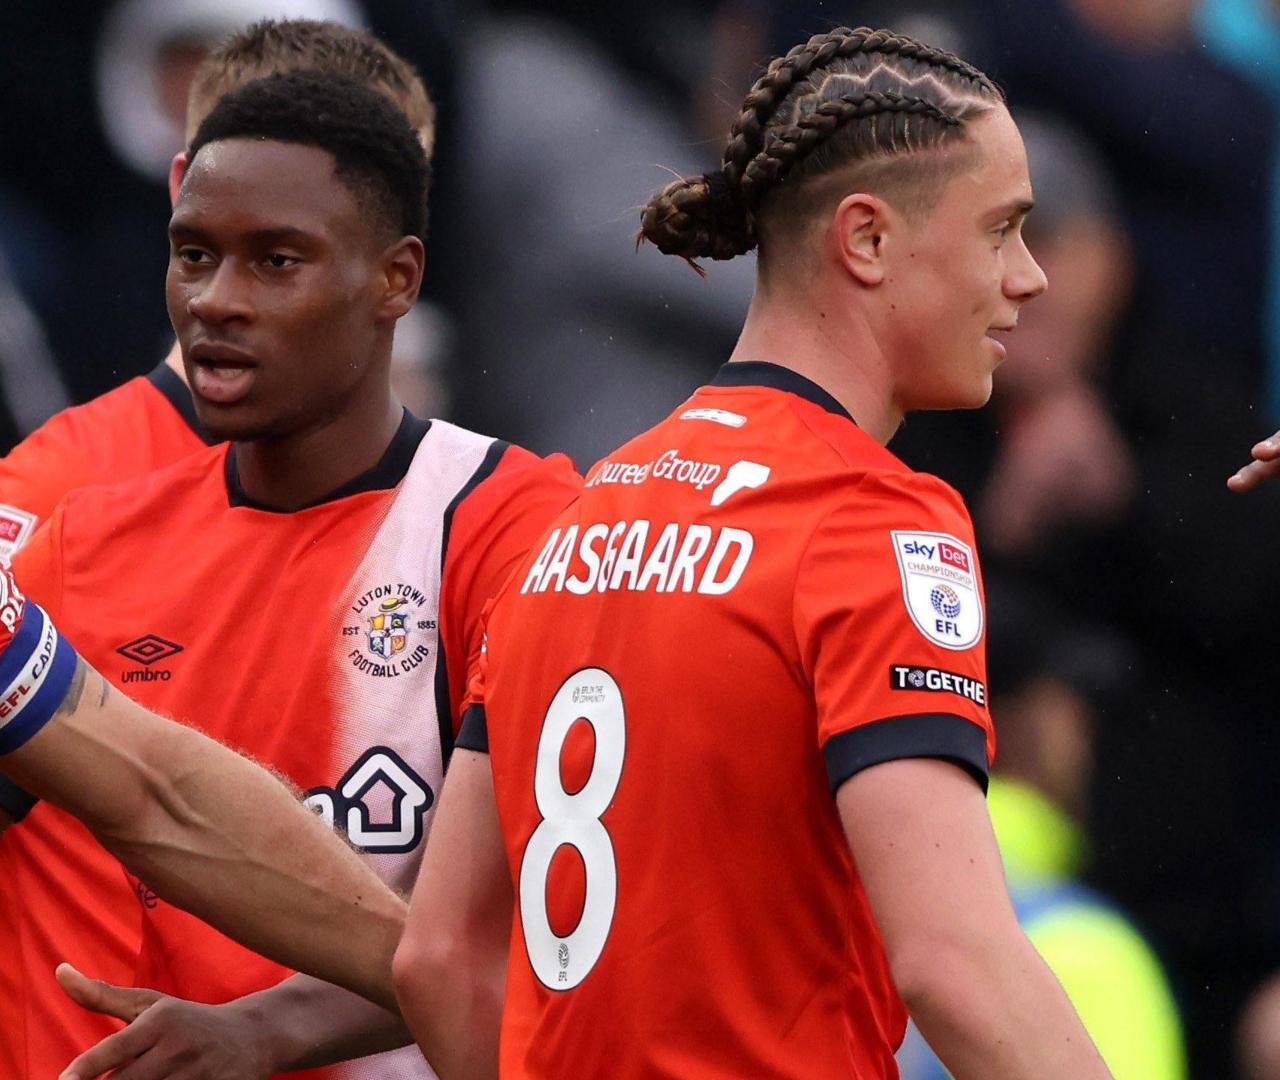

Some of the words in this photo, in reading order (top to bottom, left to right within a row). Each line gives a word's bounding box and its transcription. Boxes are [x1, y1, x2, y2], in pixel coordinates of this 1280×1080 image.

[652, 449, 721, 490] Group
[520, 519, 754, 595] AASGAARD
[903, 541, 935, 560] sky
[942, 545, 968, 568] bet
[352, 584, 392, 614] LUTON
[397, 583, 427, 608] TOWN
[342, 626, 360, 636] EST
[417, 620, 437, 630] 1885
[935, 619, 962, 638] EFL
[32, 624, 53, 680] CAPT
[348, 649, 400, 678] FOOTBALL
[401, 644, 429, 672] CLUB
[121, 667, 171, 684] umbro
[894, 667, 985, 704] TOGETHE
[520, 666, 626, 992] 8
